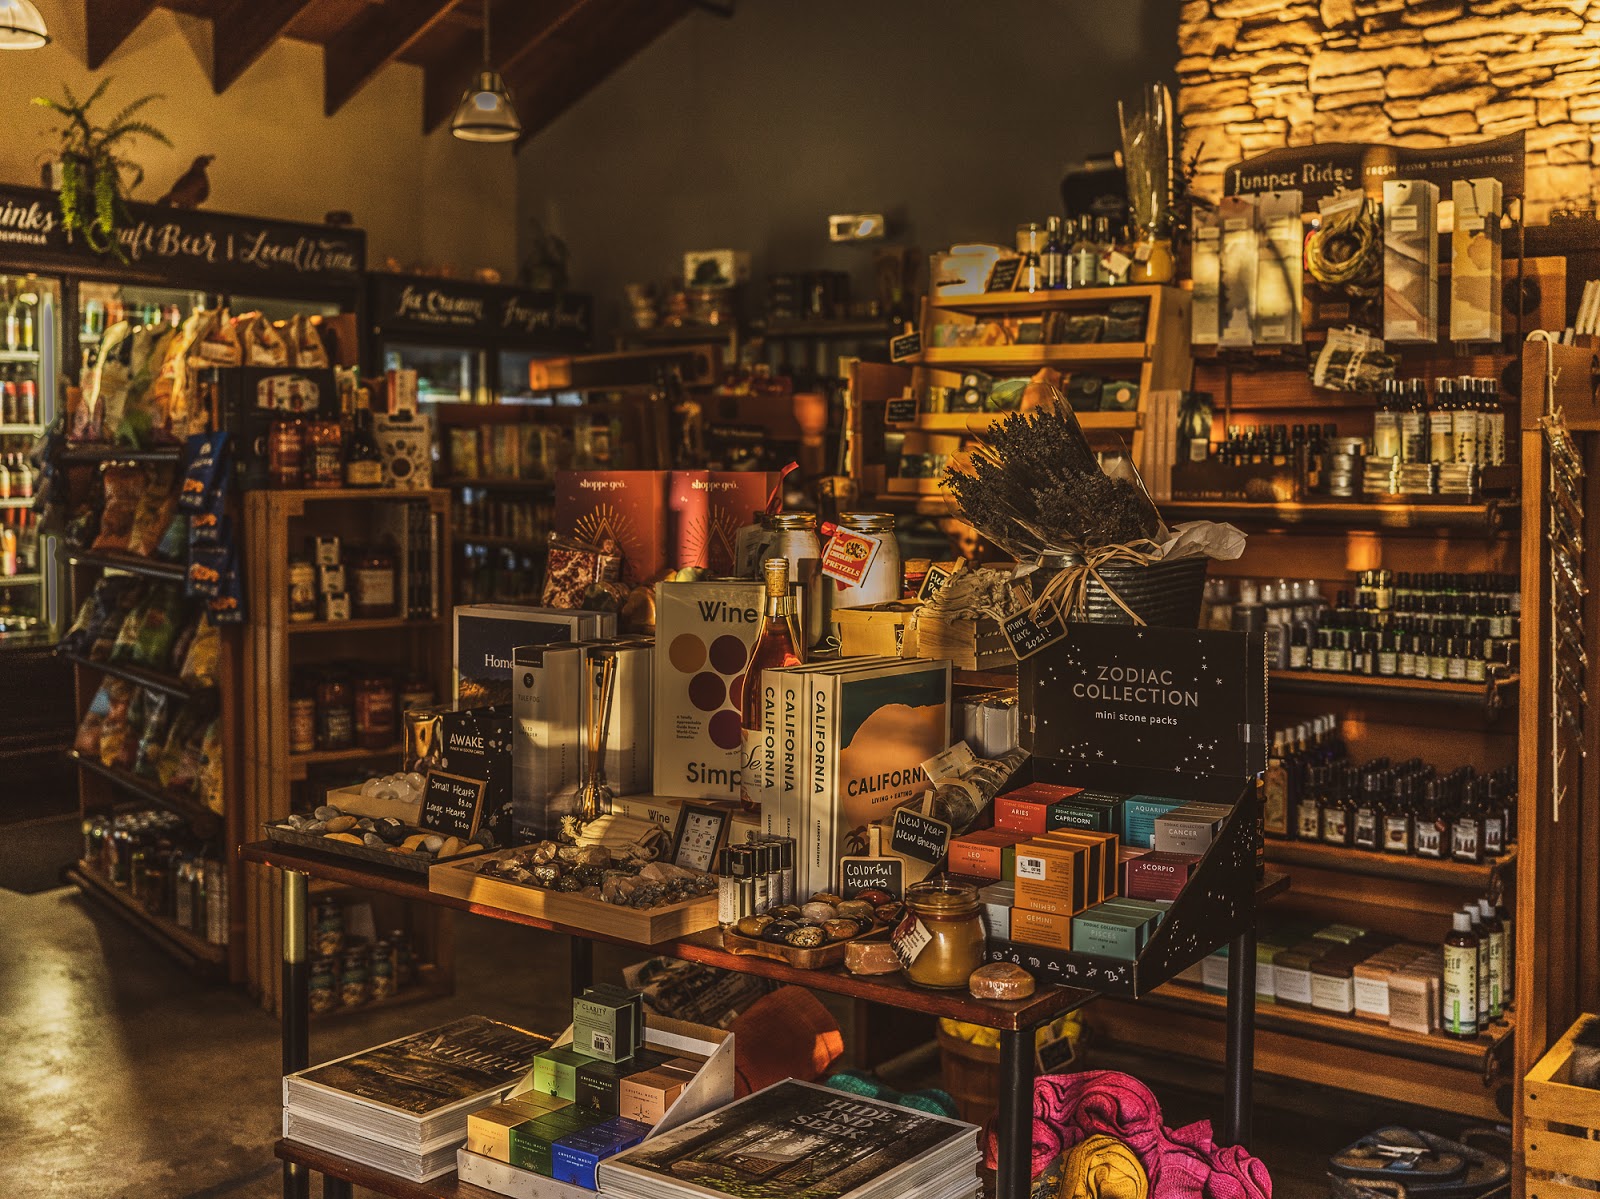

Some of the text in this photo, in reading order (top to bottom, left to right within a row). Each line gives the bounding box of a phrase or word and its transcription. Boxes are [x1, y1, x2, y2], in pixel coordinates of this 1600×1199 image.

[1234, 161, 1353, 194] Juniper Ridge
[156, 224, 217, 264] Beer
[240, 231, 306, 271] Local
[579, 478, 609, 491] shoppe
[691, 478, 720, 492] shoppe
[825, 559, 861, 577] PRETZELS
[697, 600, 759, 624] Wine
[484, 653, 514, 670] Home
[1097, 665, 1173, 686] ZODIAC
[1072, 683, 1199, 708] COLLECTION
[1095, 710, 1178, 727] mini stone packs
[449, 733, 485, 749] AWAKE
[764, 686, 775, 790] CALIFORNIA
[784, 689, 795, 793] CALIFORNIA
[814, 690, 826, 794] CALIFORNIA
[741, 744, 762, 771] Se
[686, 761, 742, 793] Simp
[431, 778, 476, 799] Small Hearts
[871, 795, 889, 805] LIVING
[895, 789, 913, 800] EATING
[426, 801, 467, 819] Large Hearts
[1011, 808, 1029, 817] ARIES
[1018, 803, 1040, 811] COLLECTION
[1069, 810, 1094, 818] COLLECTION
[1135, 805, 1169, 814] AQUARIUS
[647, 809, 670, 824] Wine
[1054, 814, 1091, 825] CAPRICORN
[898, 812, 944, 837] New Year
[1168, 828, 1198, 837] CANCER
[895, 829, 946, 860] New Energy!
[971, 845, 995, 853] COLLECTION
[967, 851, 981, 859] LEO
[846, 863, 892, 876] Colorful
[1142, 863, 1176, 873] SCORPIO
[847, 877, 888, 888] Hearts
[1030, 901, 1057, 912] GEMINI
[1026, 914, 1052, 924] GEMINI
[1083, 922, 1128, 933] ZODIAC COLLECTION
[1090, 930, 1117, 940] PISCES
[581, 1003, 607, 1015] CLARITY
[580, 1075, 598, 1085] CRYSTAL
[599, 1080, 613, 1088] MAGIC
[625, 1088, 643, 1097] CRYSTAL
[812, 1109, 874, 1128] AND
[824, 1099, 898, 1123] HIDE
[790, 1115, 867, 1140] SEEK
[514, 1137, 547, 1151] CRYSTAL MAGIC
[558, 1151, 577, 1161] CRYSTAL
[578, 1157, 592, 1166] MAGIC
